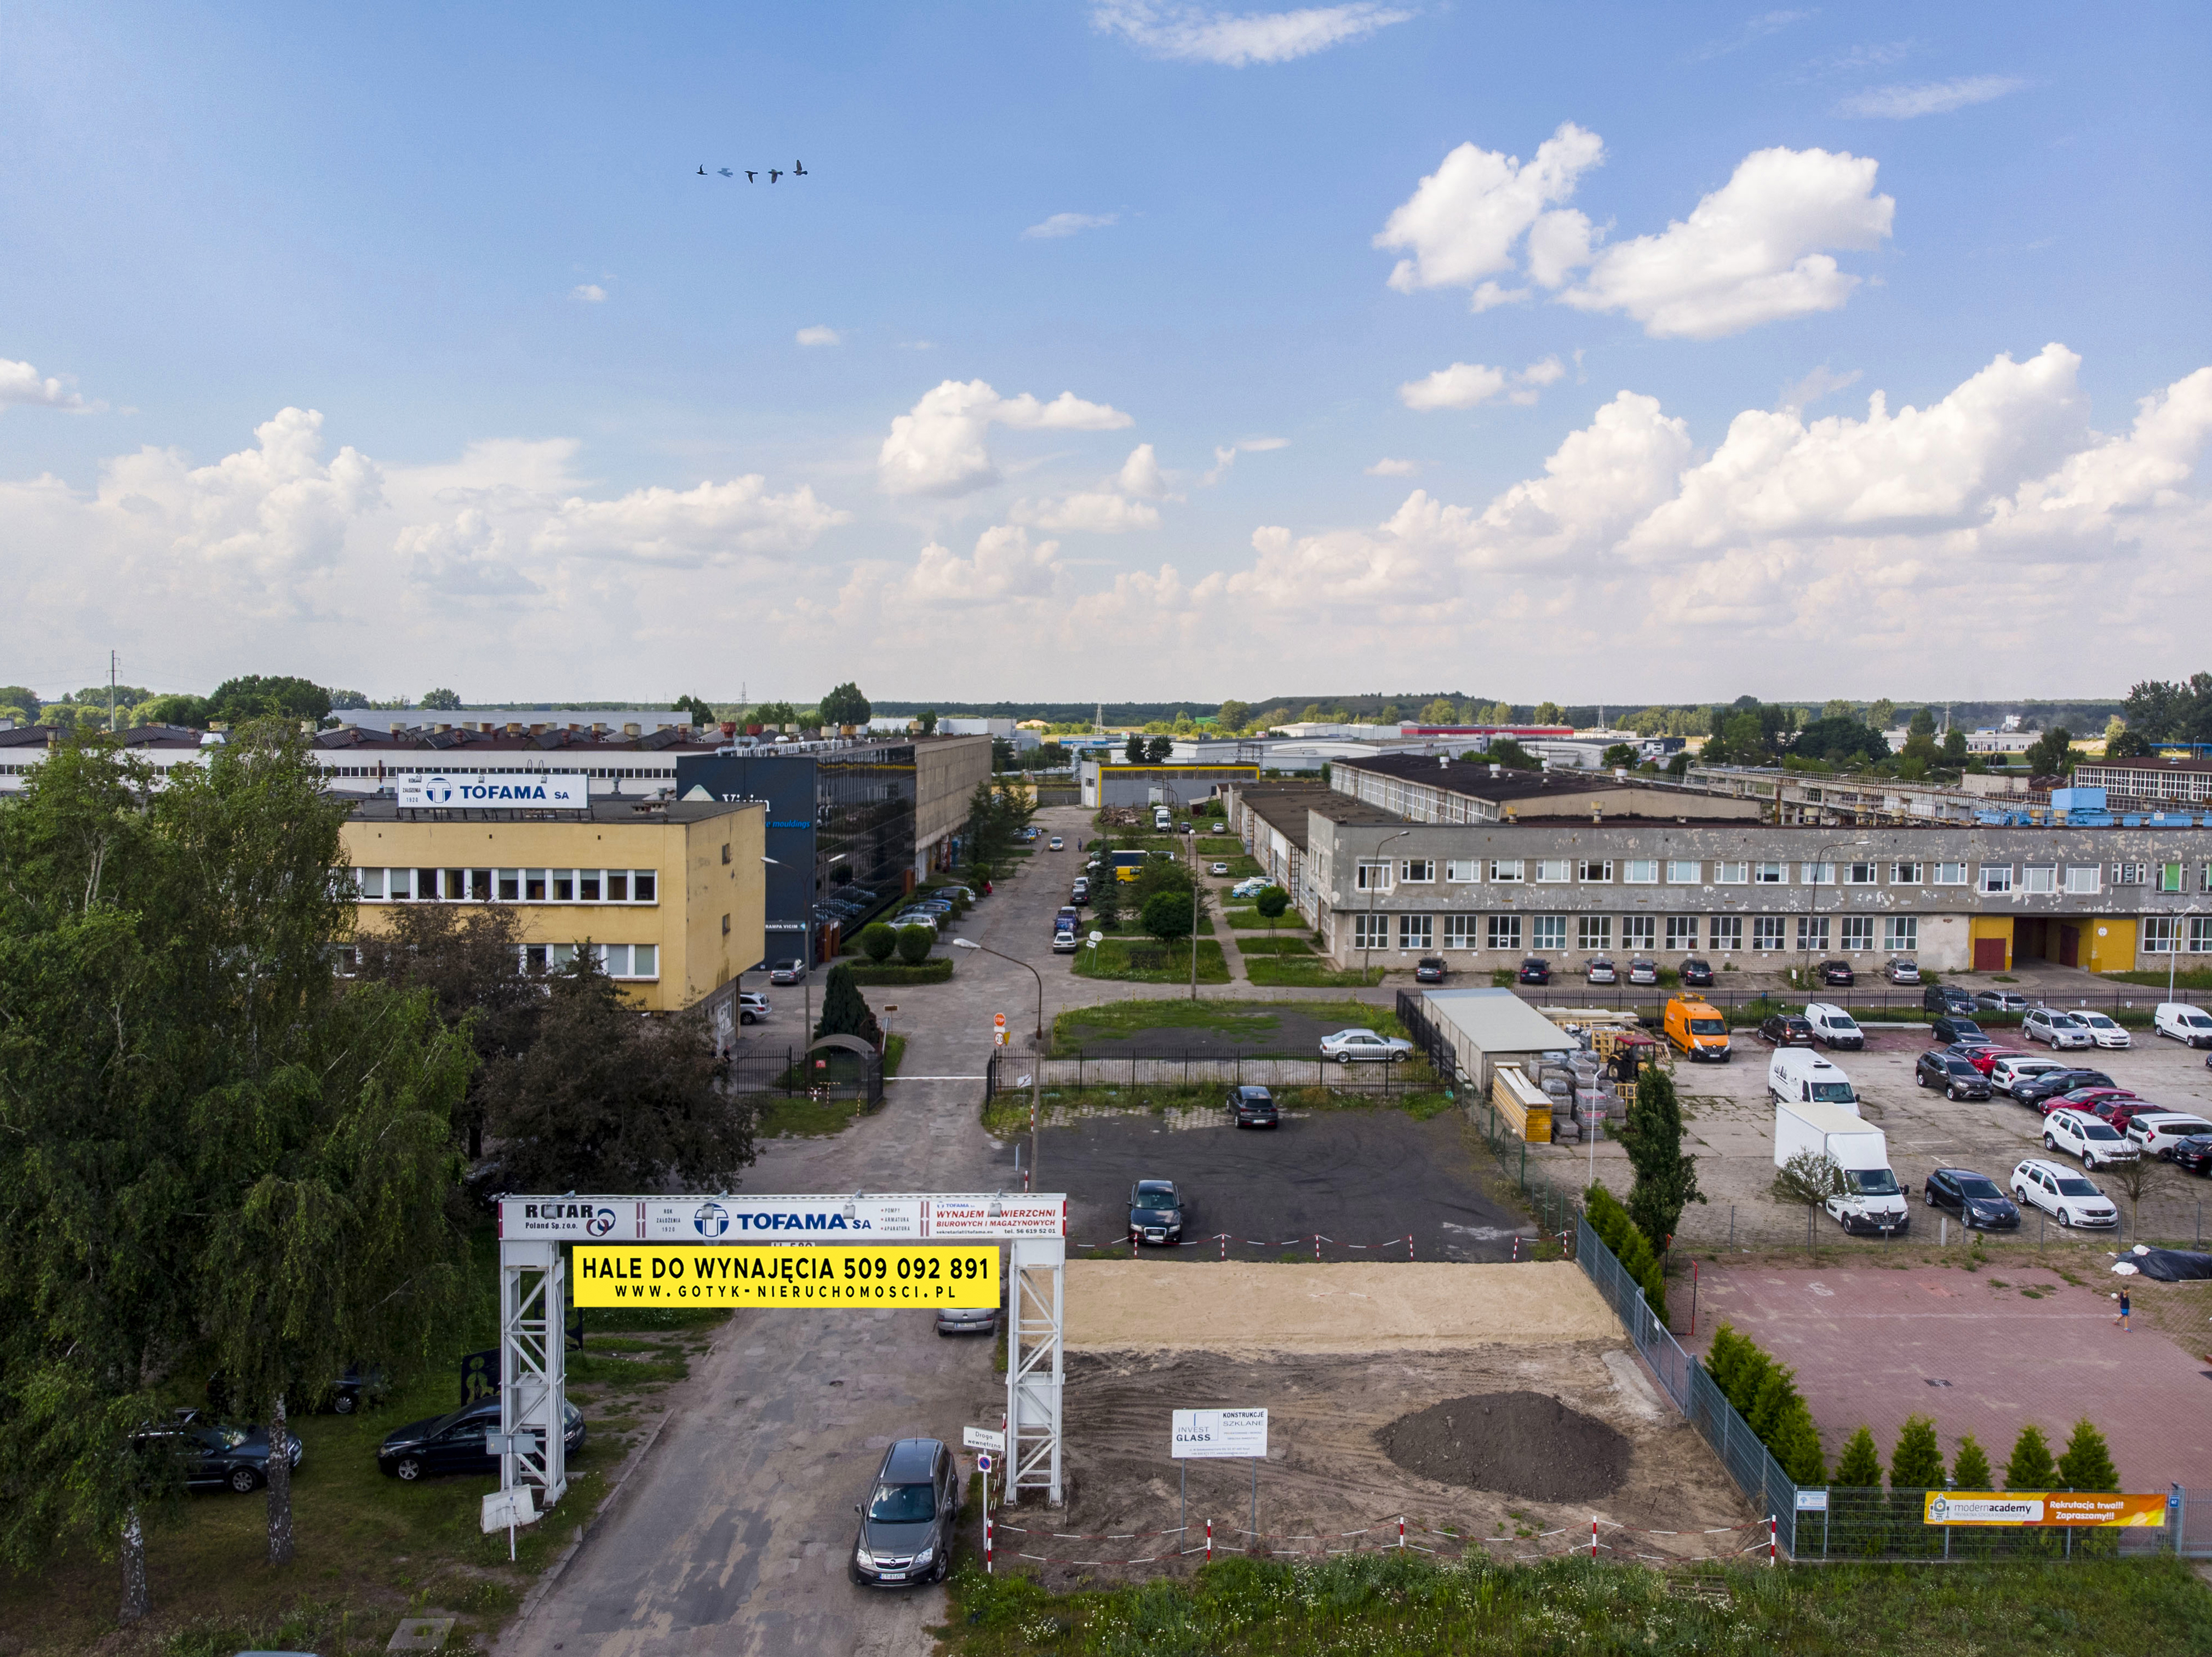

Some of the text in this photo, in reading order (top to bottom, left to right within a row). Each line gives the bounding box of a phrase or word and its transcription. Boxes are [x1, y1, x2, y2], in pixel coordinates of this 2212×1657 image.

[460, 786, 569, 800] TOFAMA SA
[772, 820, 810, 830] mouldings
[525, 1205, 593, 1218] RTAR
[737, 1213, 872, 1230] TOFAMA SA
[583, 1257, 987, 1283] HALE DO WYNAJĘCIA 509 092 891
[615, 1285, 955, 1298] WWW.GOTYK-NIERUCHOMOSCI.PL
[975, 1431, 993, 1440] Droga
[967, 1440, 1001, 1449] wewnętrzna
[1954, 1503, 2031, 1514] modernacademy
[2050, 1501, 2124, 1510] Rekrutacja trwa!!!
[2056, 1511, 2115, 1521] Zapraszamy!!!
